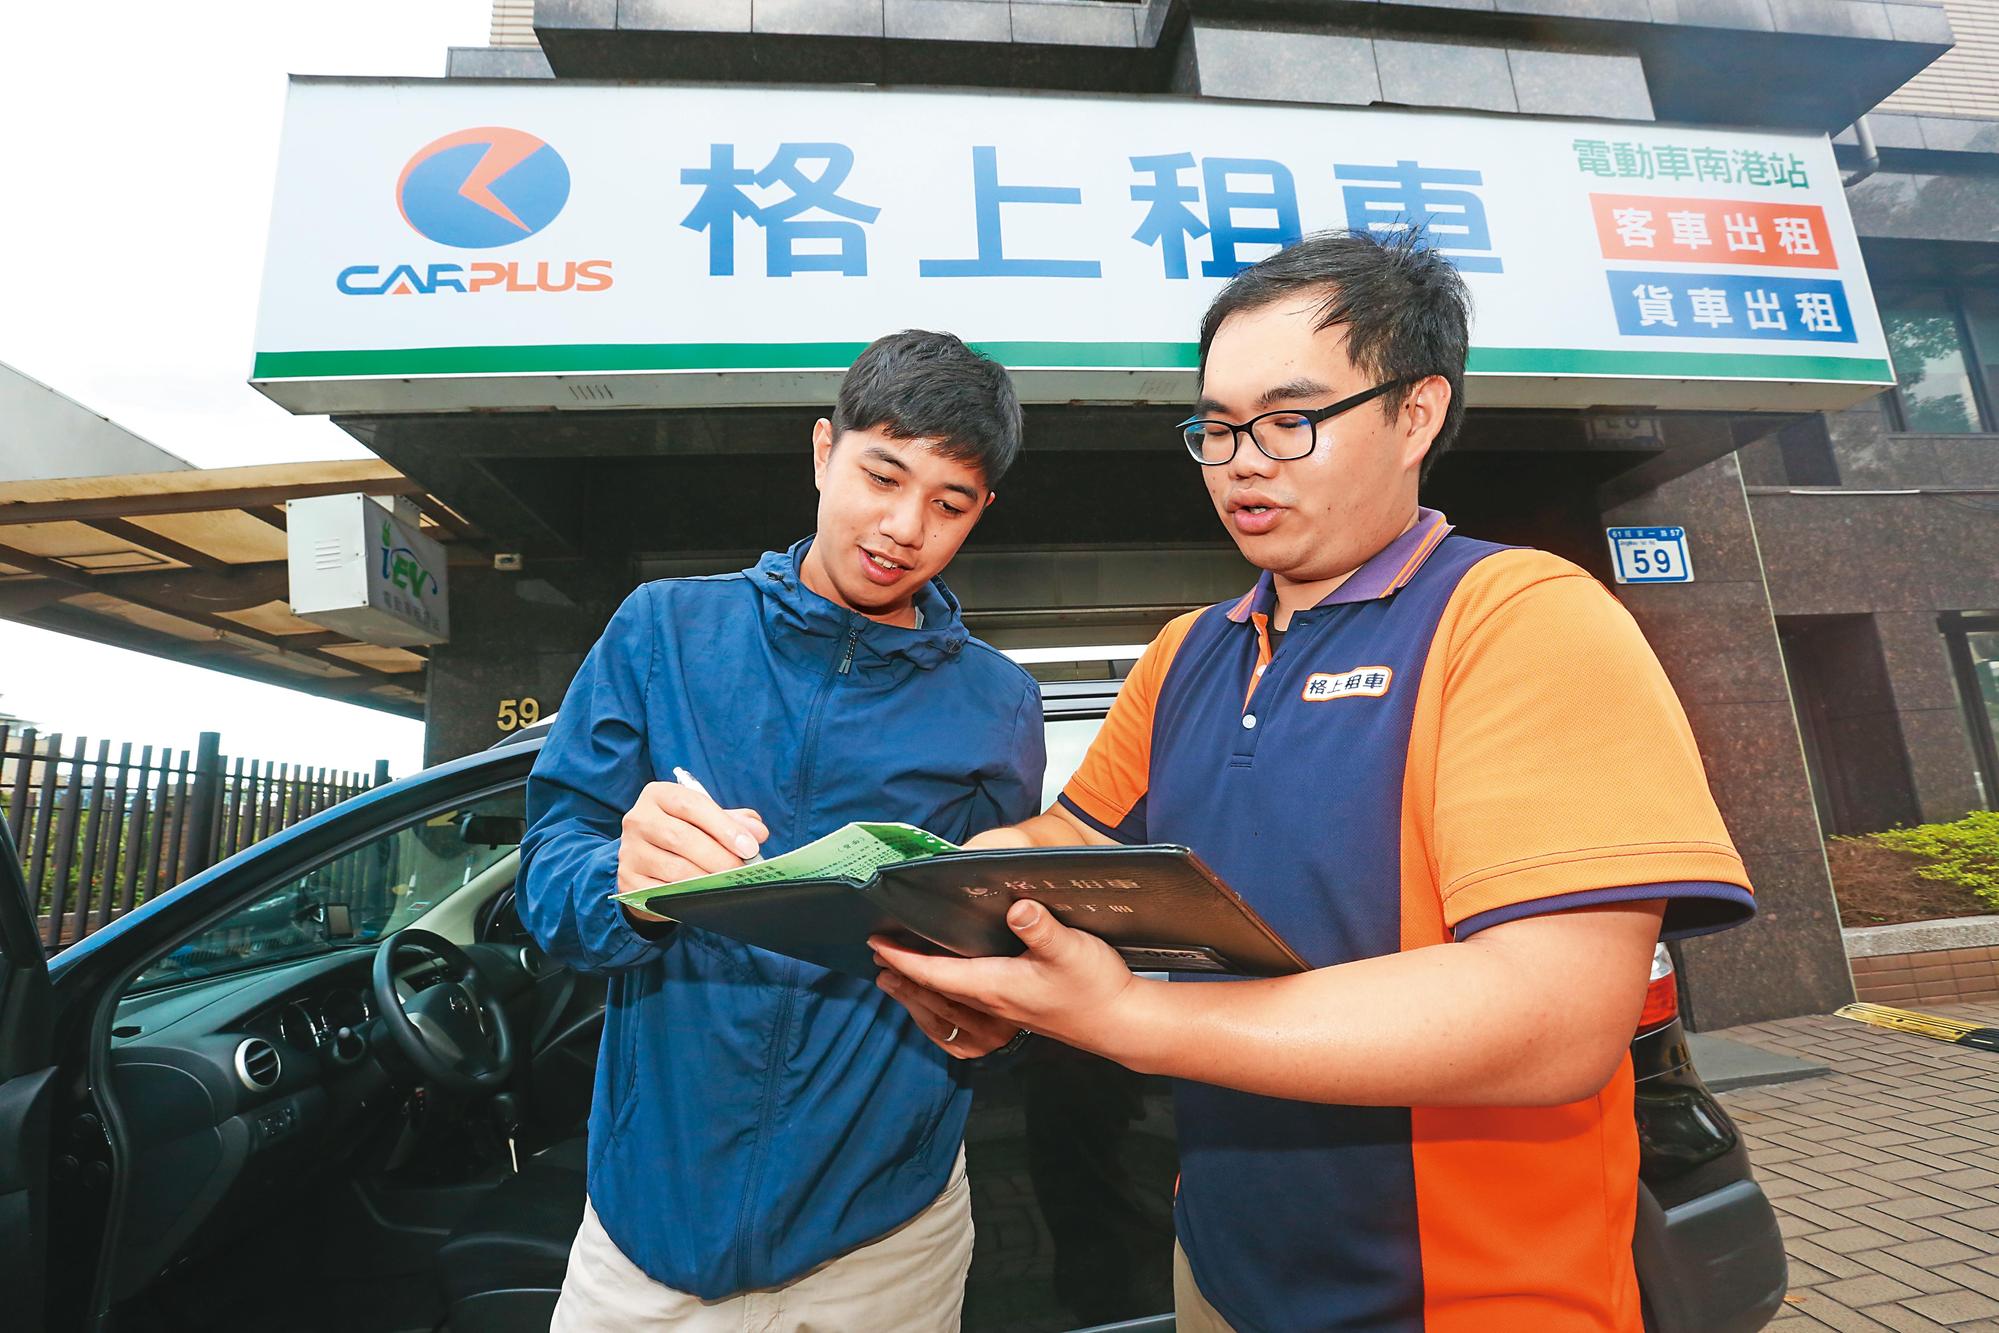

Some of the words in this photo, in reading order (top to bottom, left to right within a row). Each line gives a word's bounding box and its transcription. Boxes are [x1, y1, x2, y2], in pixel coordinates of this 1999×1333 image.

[1572, 138, 1810, 190] 電動車南港站
[679, 142, 1504, 280] 格上租車
[1612, 207, 1820, 257] 客車出租
[336, 259, 613, 295] CARPLUS
[1632, 284, 1843, 333] 貨車出租
[1633, 548, 1671, 575] 59
[1309, 672, 1386, 695] 格上租車
[497, 697, 540, 731] 59
